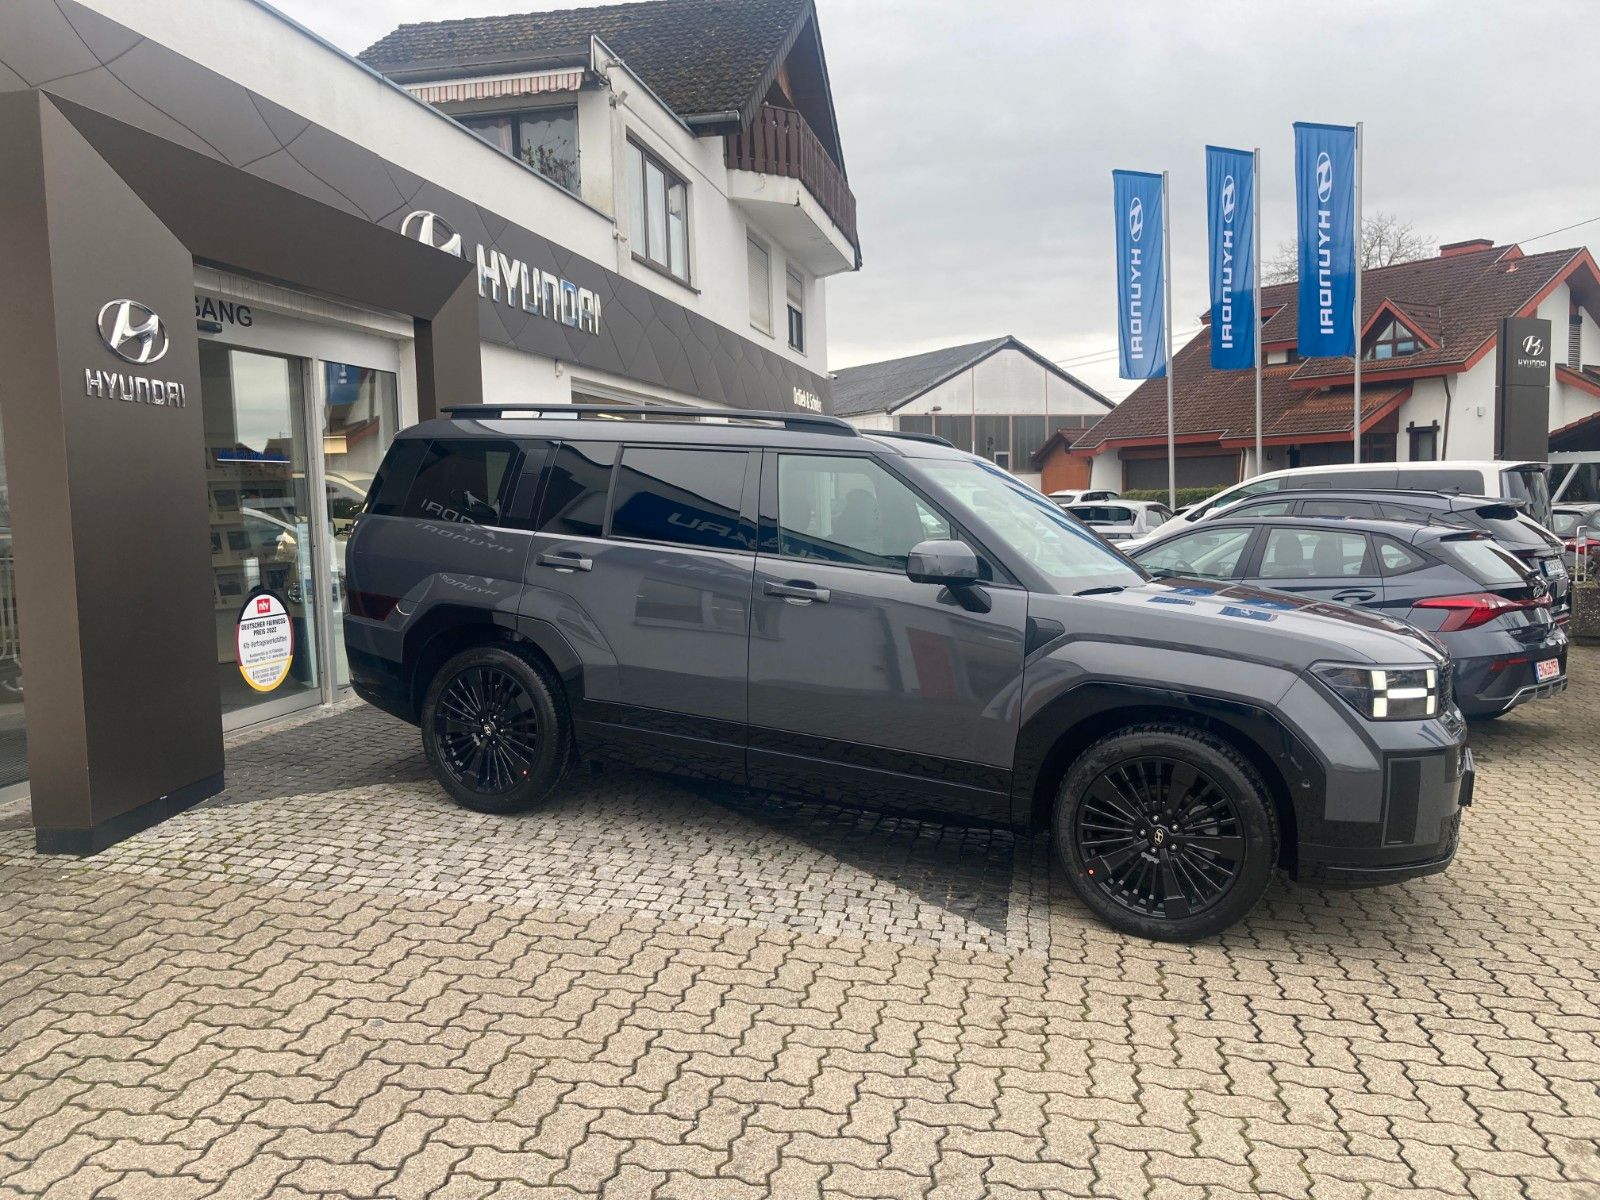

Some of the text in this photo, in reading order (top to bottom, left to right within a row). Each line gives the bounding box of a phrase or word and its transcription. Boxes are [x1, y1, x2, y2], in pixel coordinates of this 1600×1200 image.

[476, 243, 601, 336] HYUNDAI
[1518, 359, 1547, 368] HYUNDAI
[85, 368, 186, 408] HYUNDAI
